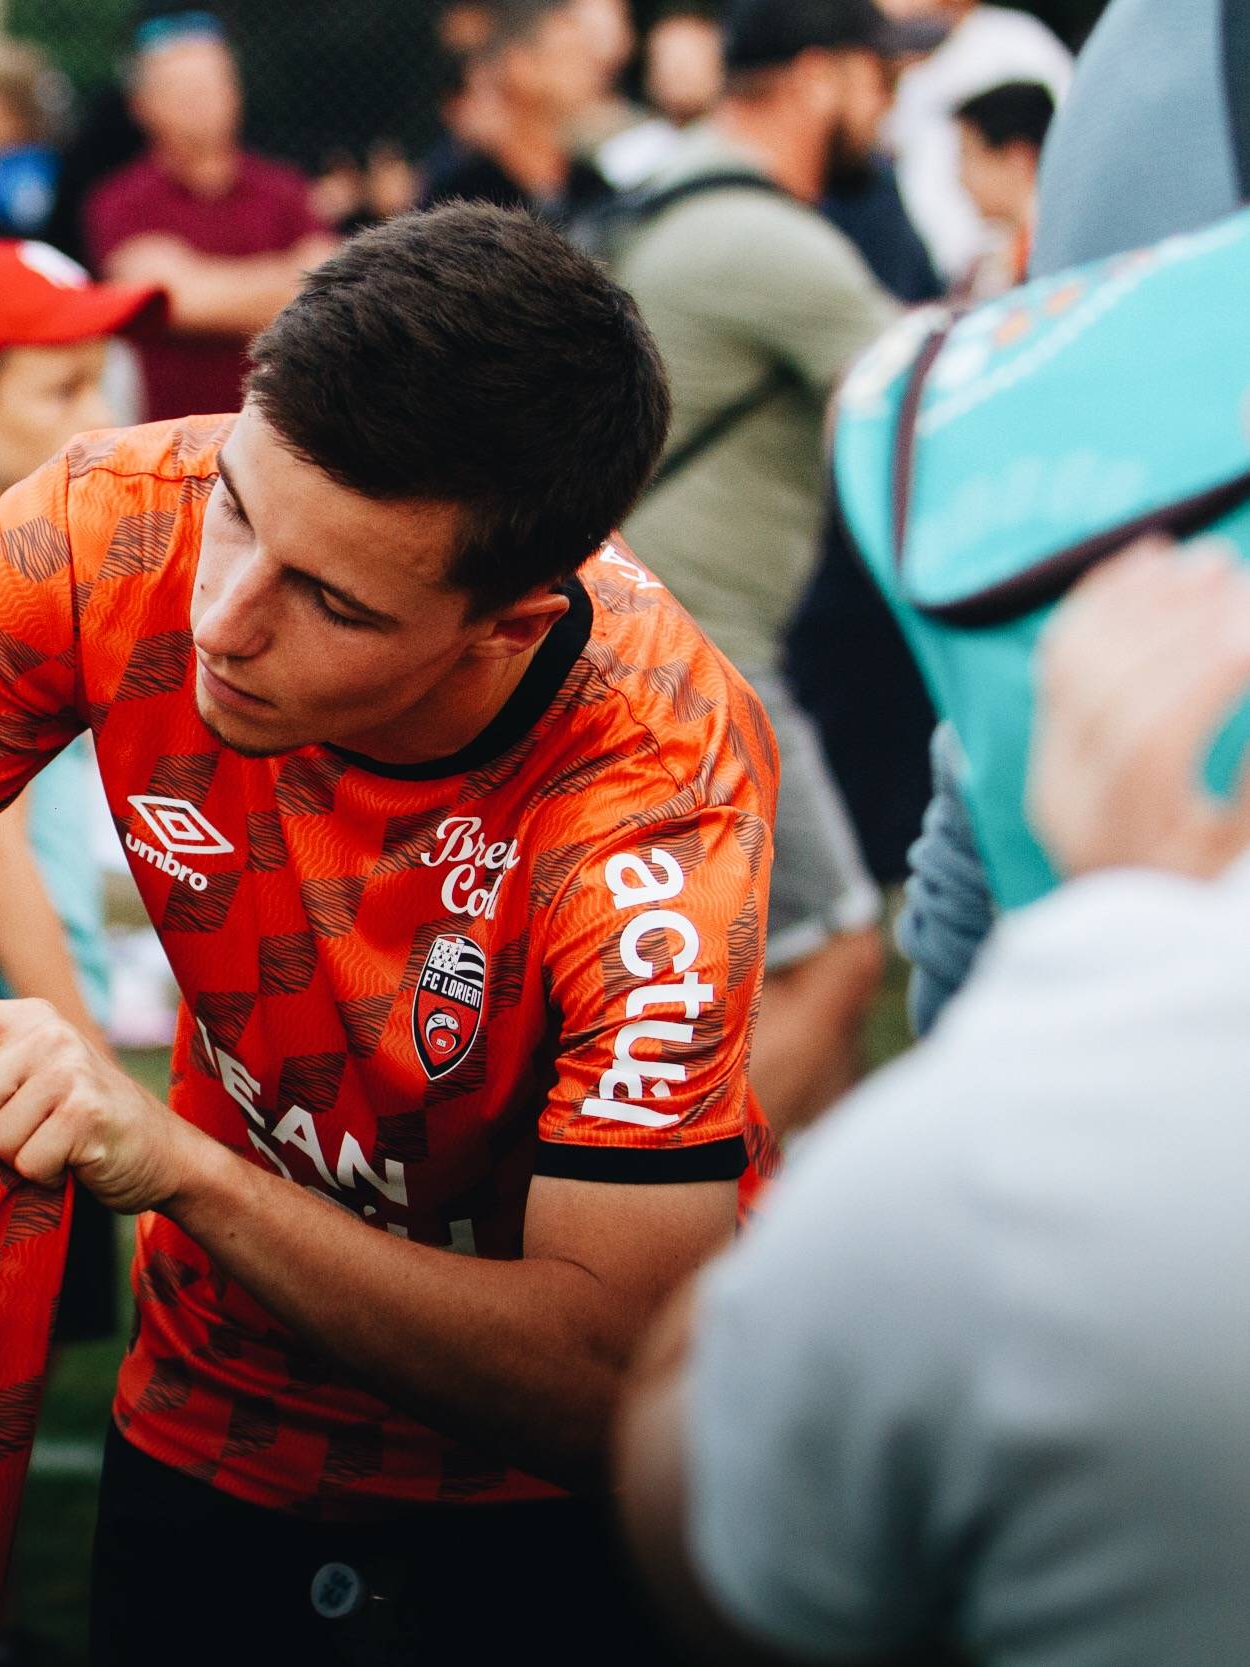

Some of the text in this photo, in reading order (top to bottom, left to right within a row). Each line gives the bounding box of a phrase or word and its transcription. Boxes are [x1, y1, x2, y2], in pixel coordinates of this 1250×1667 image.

[126, 832, 208, 891] umbro
[422, 970, 482, 1008] FC LORIENT
